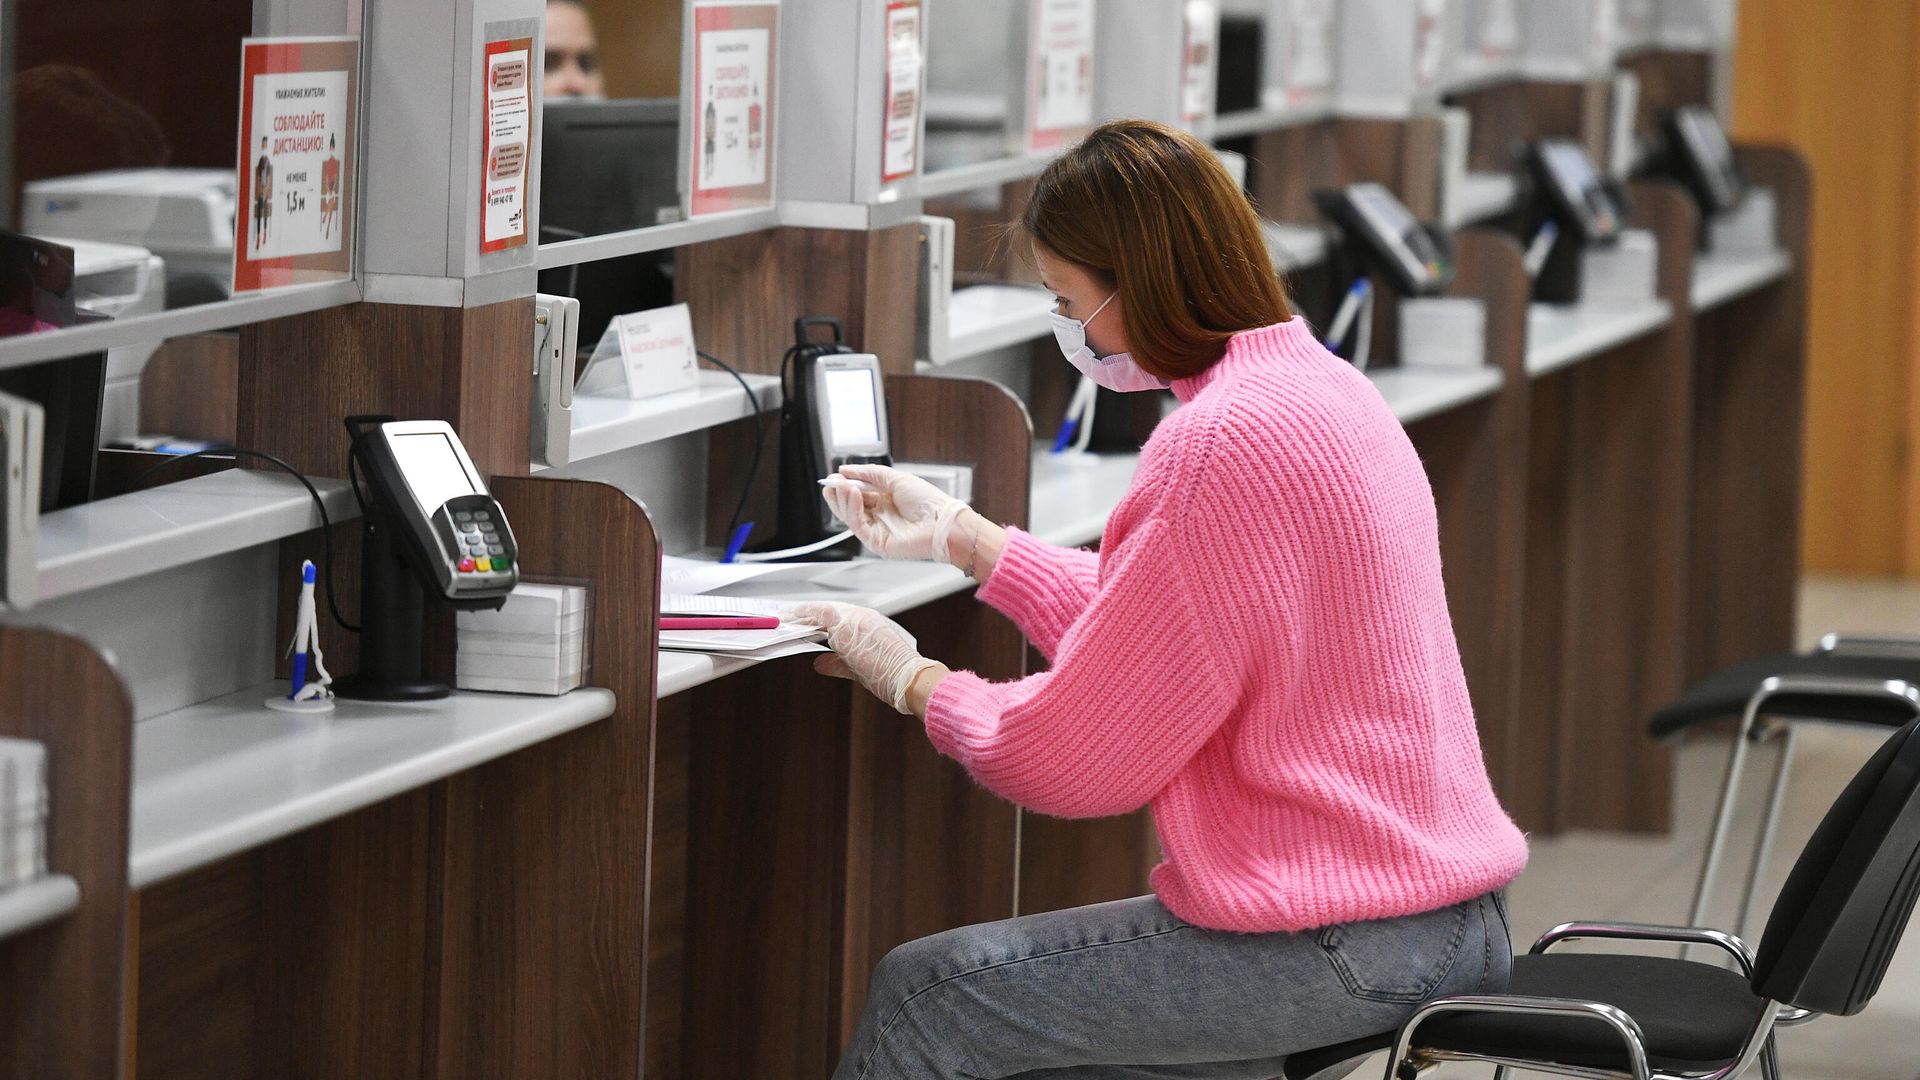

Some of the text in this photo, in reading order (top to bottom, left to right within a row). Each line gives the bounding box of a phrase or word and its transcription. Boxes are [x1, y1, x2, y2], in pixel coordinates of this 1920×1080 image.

[273, 111, 325, 132] СОБЛЮДАЙТЕ
[273, 136, 324, 156] ДИСТАНЦИЮ!
[286, 190, 297, 214] 1,5
